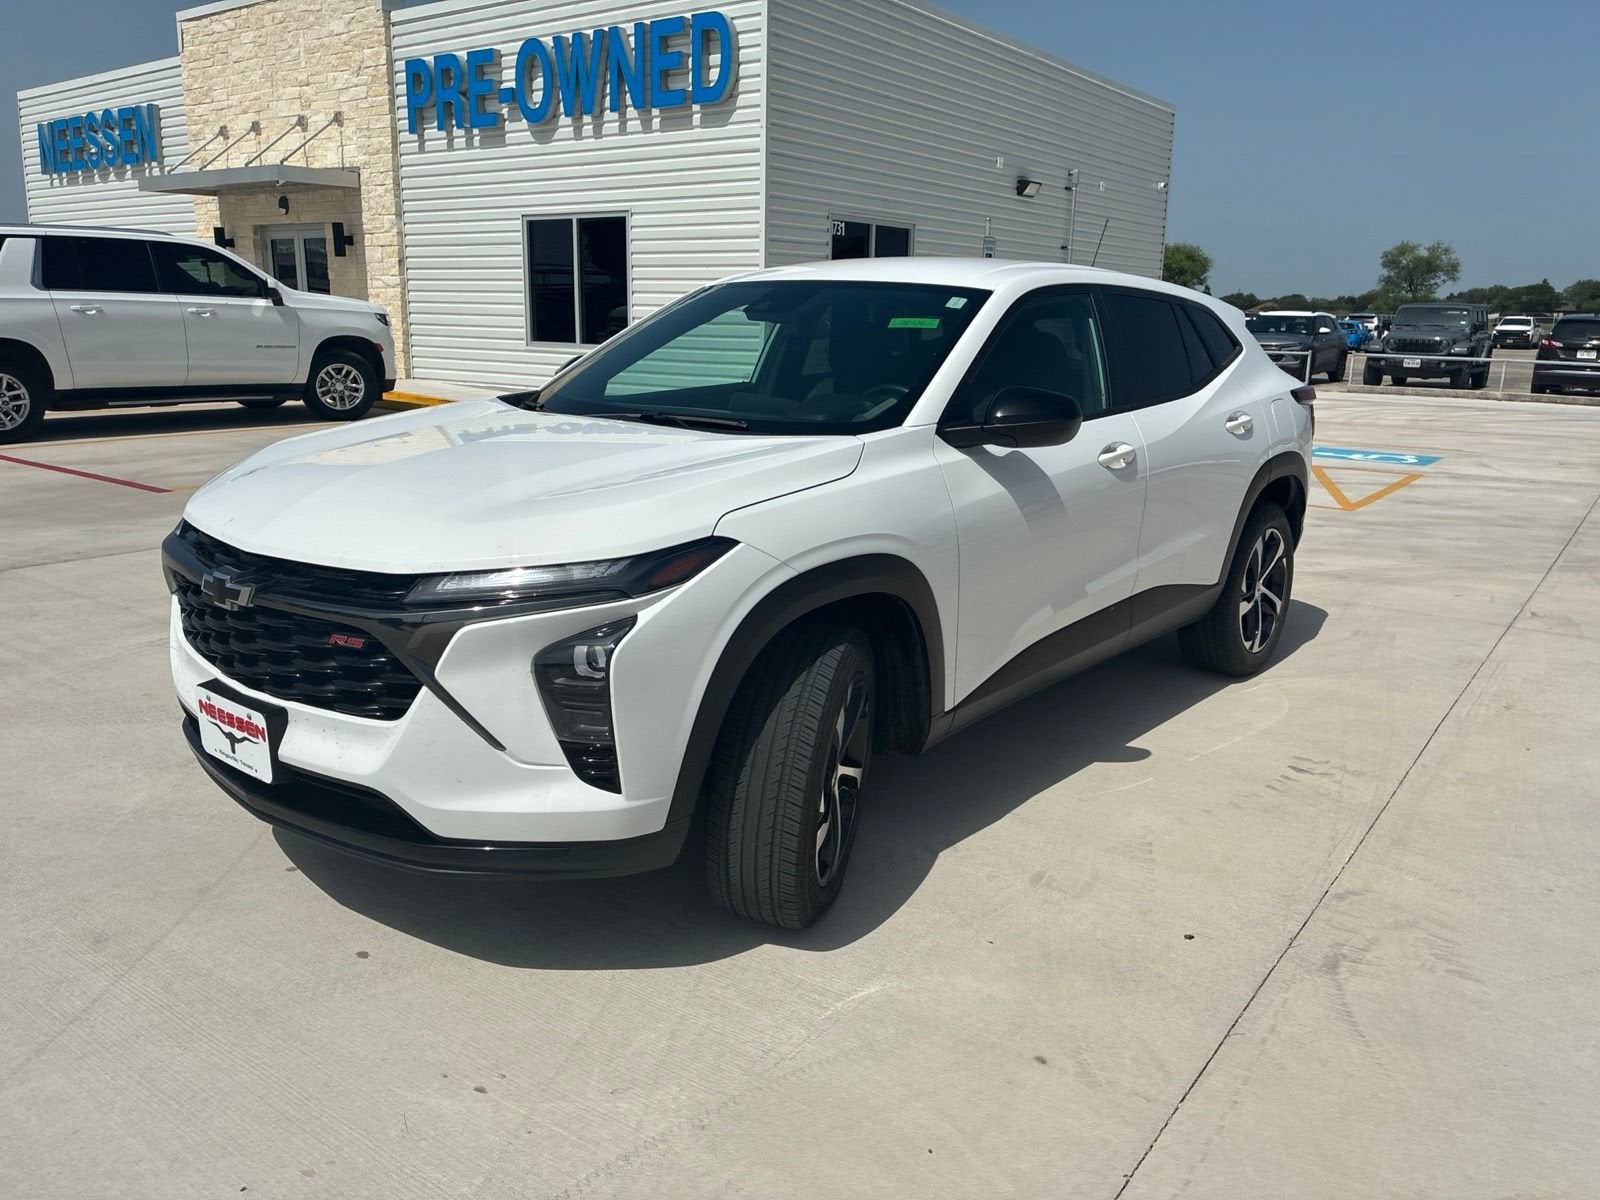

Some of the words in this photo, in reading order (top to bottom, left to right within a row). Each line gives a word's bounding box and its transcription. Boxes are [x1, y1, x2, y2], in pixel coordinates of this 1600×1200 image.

[404, 10, 738, 135] PRE-OWNED
[37, 103, 160, 175] NEESSEN
[329, 633, 365, 649] RS
[198, 698, 267, 743] NEESSEN
